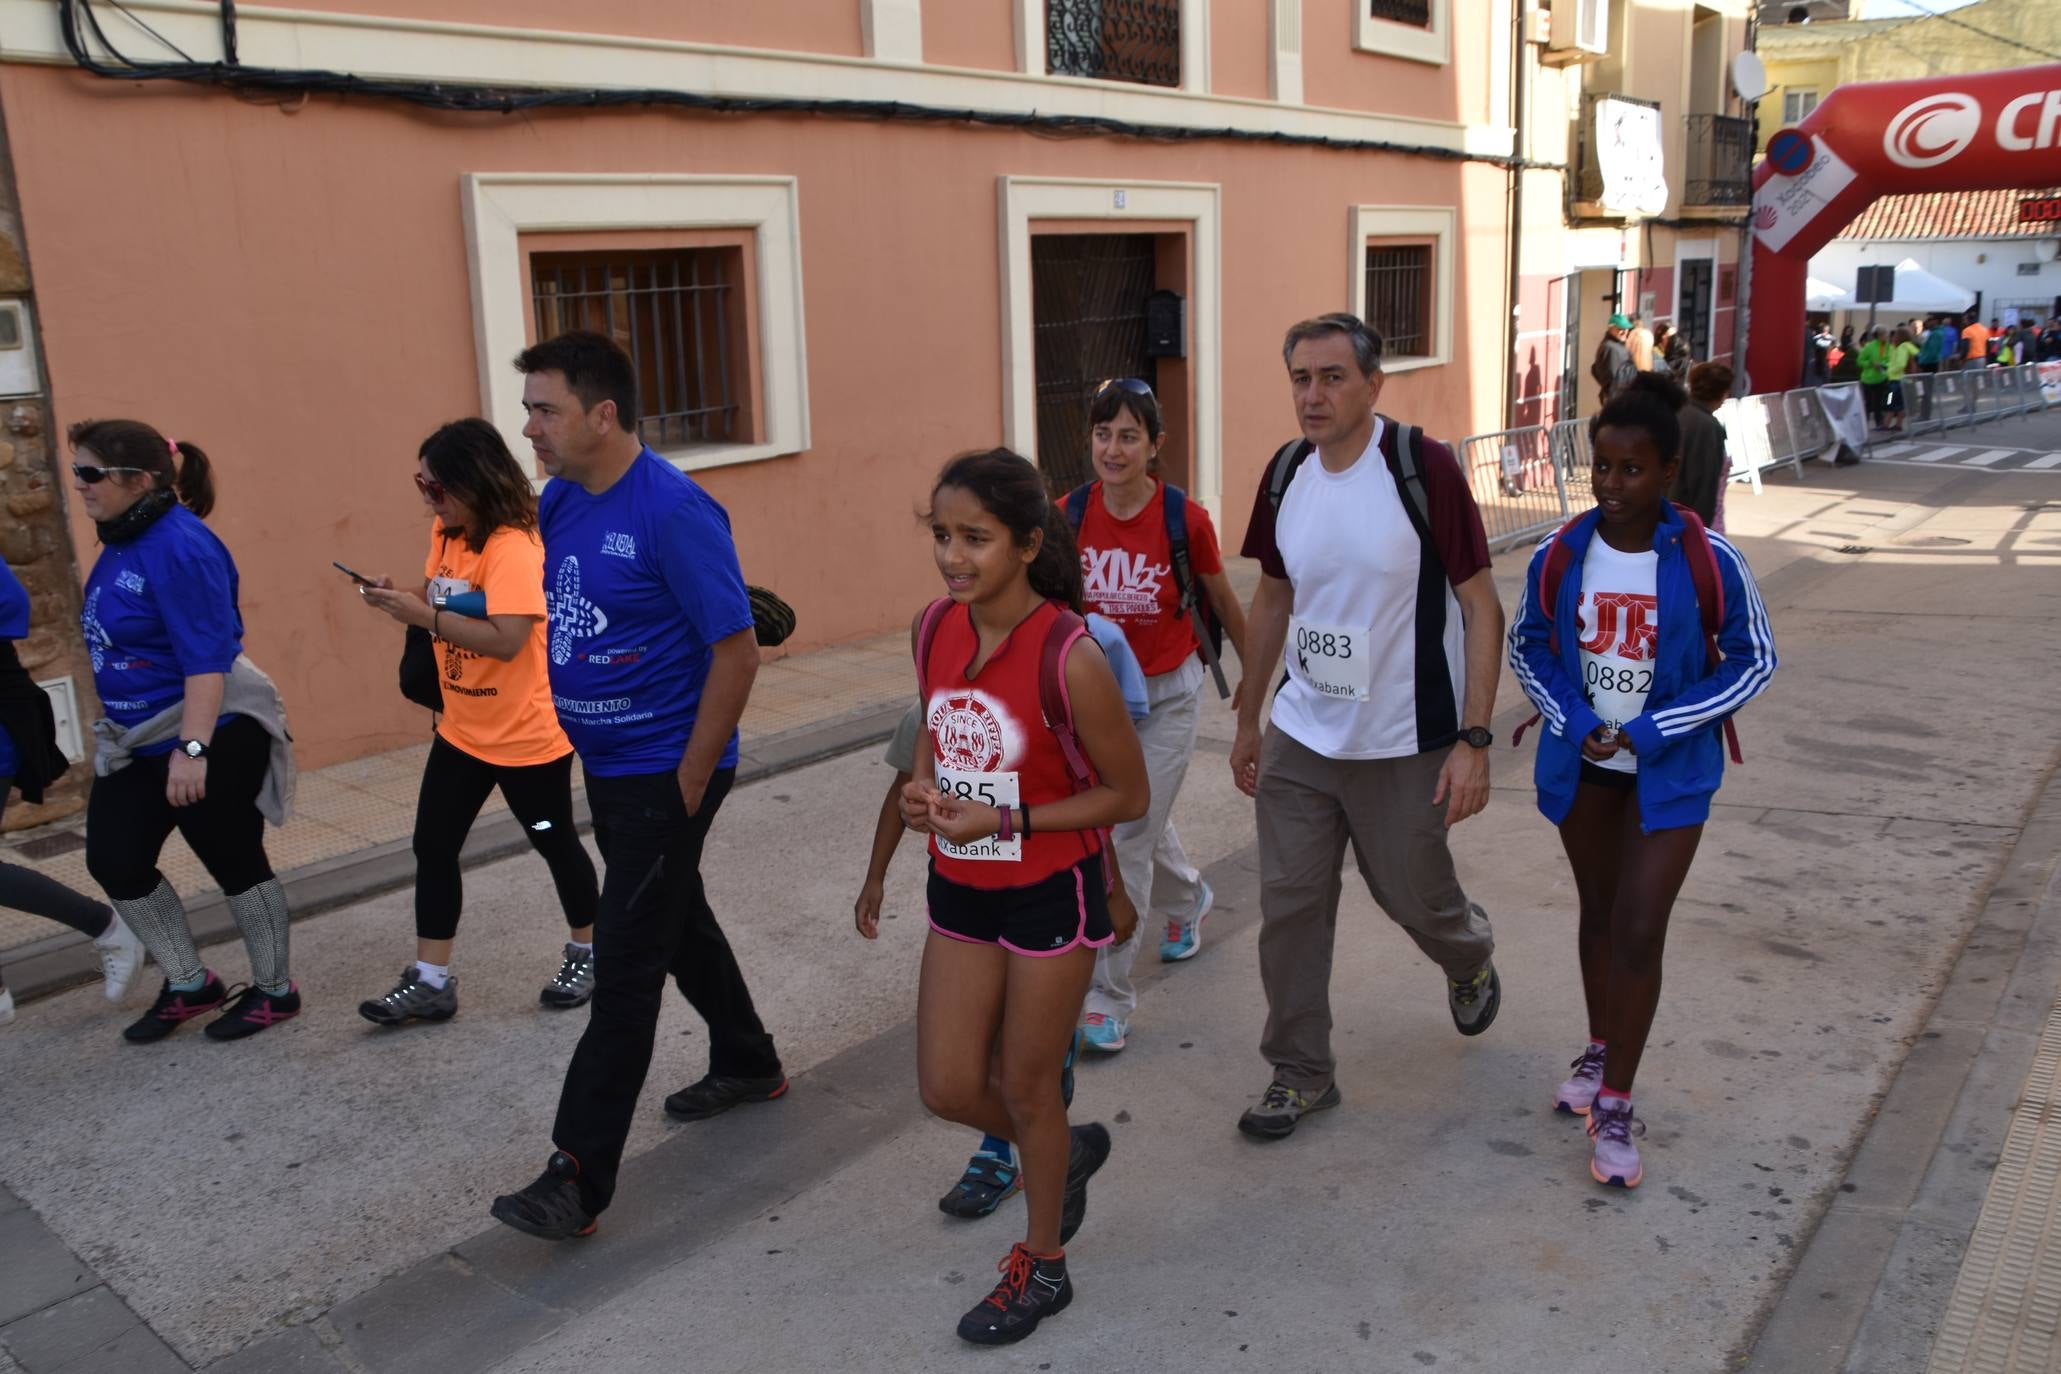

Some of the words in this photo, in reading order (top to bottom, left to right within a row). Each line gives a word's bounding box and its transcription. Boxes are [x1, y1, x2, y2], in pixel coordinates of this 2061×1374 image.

[1297, 627, 1352, 659] 0883
[1311, 680, 1355, 697] xabank
[1587, 661, 1653, 693] 0882
[951, 714, 977, 729] SINCE
[938, 776, 996, 807] 885
